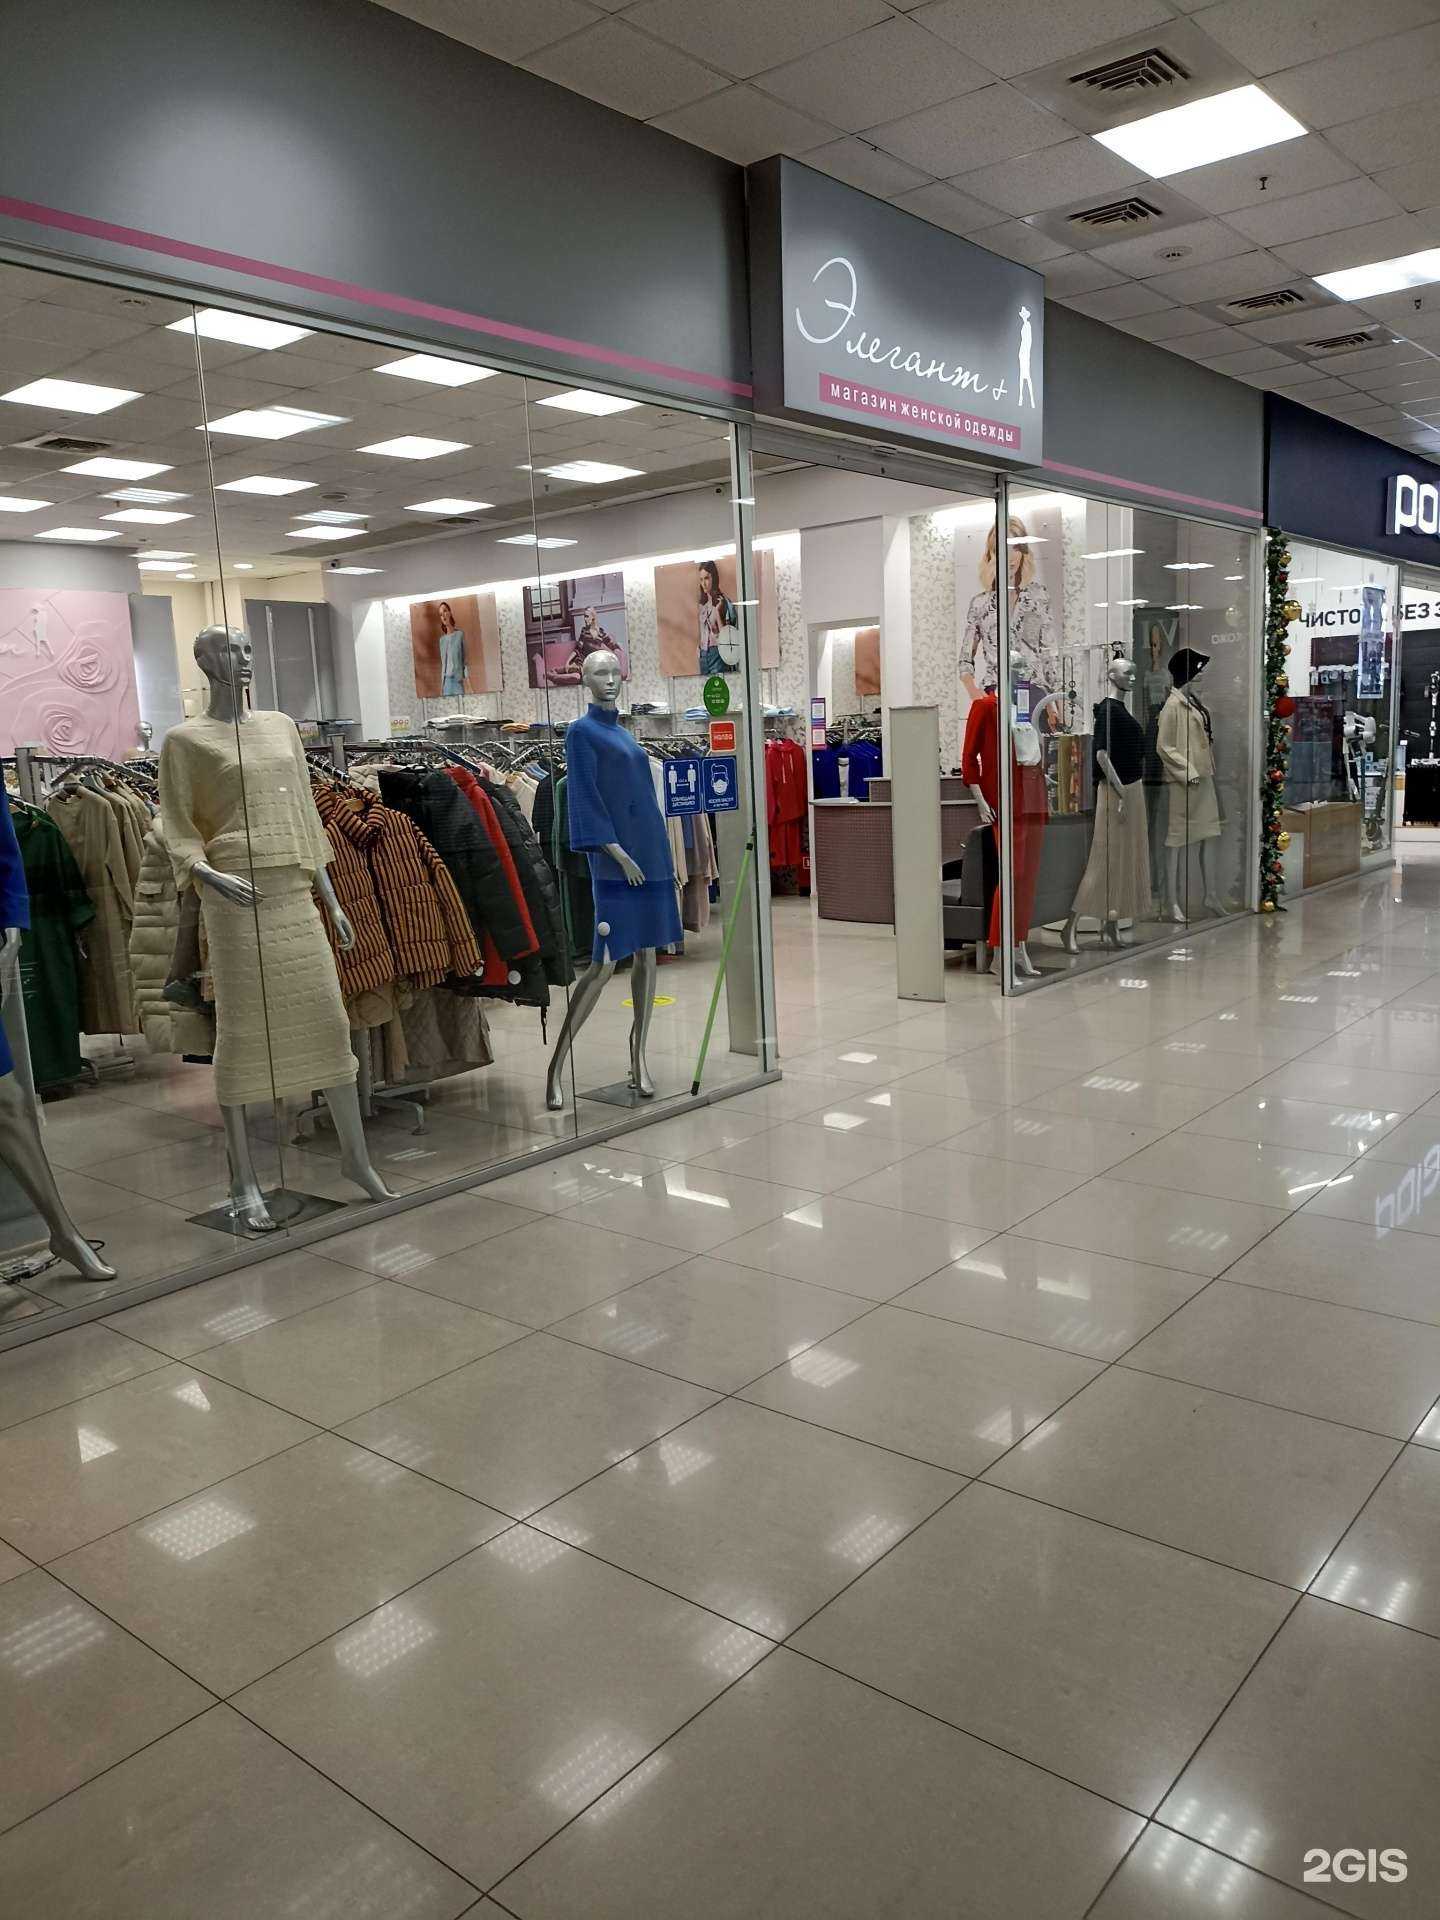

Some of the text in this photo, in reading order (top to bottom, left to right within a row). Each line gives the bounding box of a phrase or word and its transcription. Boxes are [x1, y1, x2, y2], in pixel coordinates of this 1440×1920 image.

[796, 257, 988, 393] Элегант
[830, 383, 1014, 442] магазин женской одежды
[1395, 474, 1440, 534] po
[1299, 608, 1361, 628] ЧИСТО
